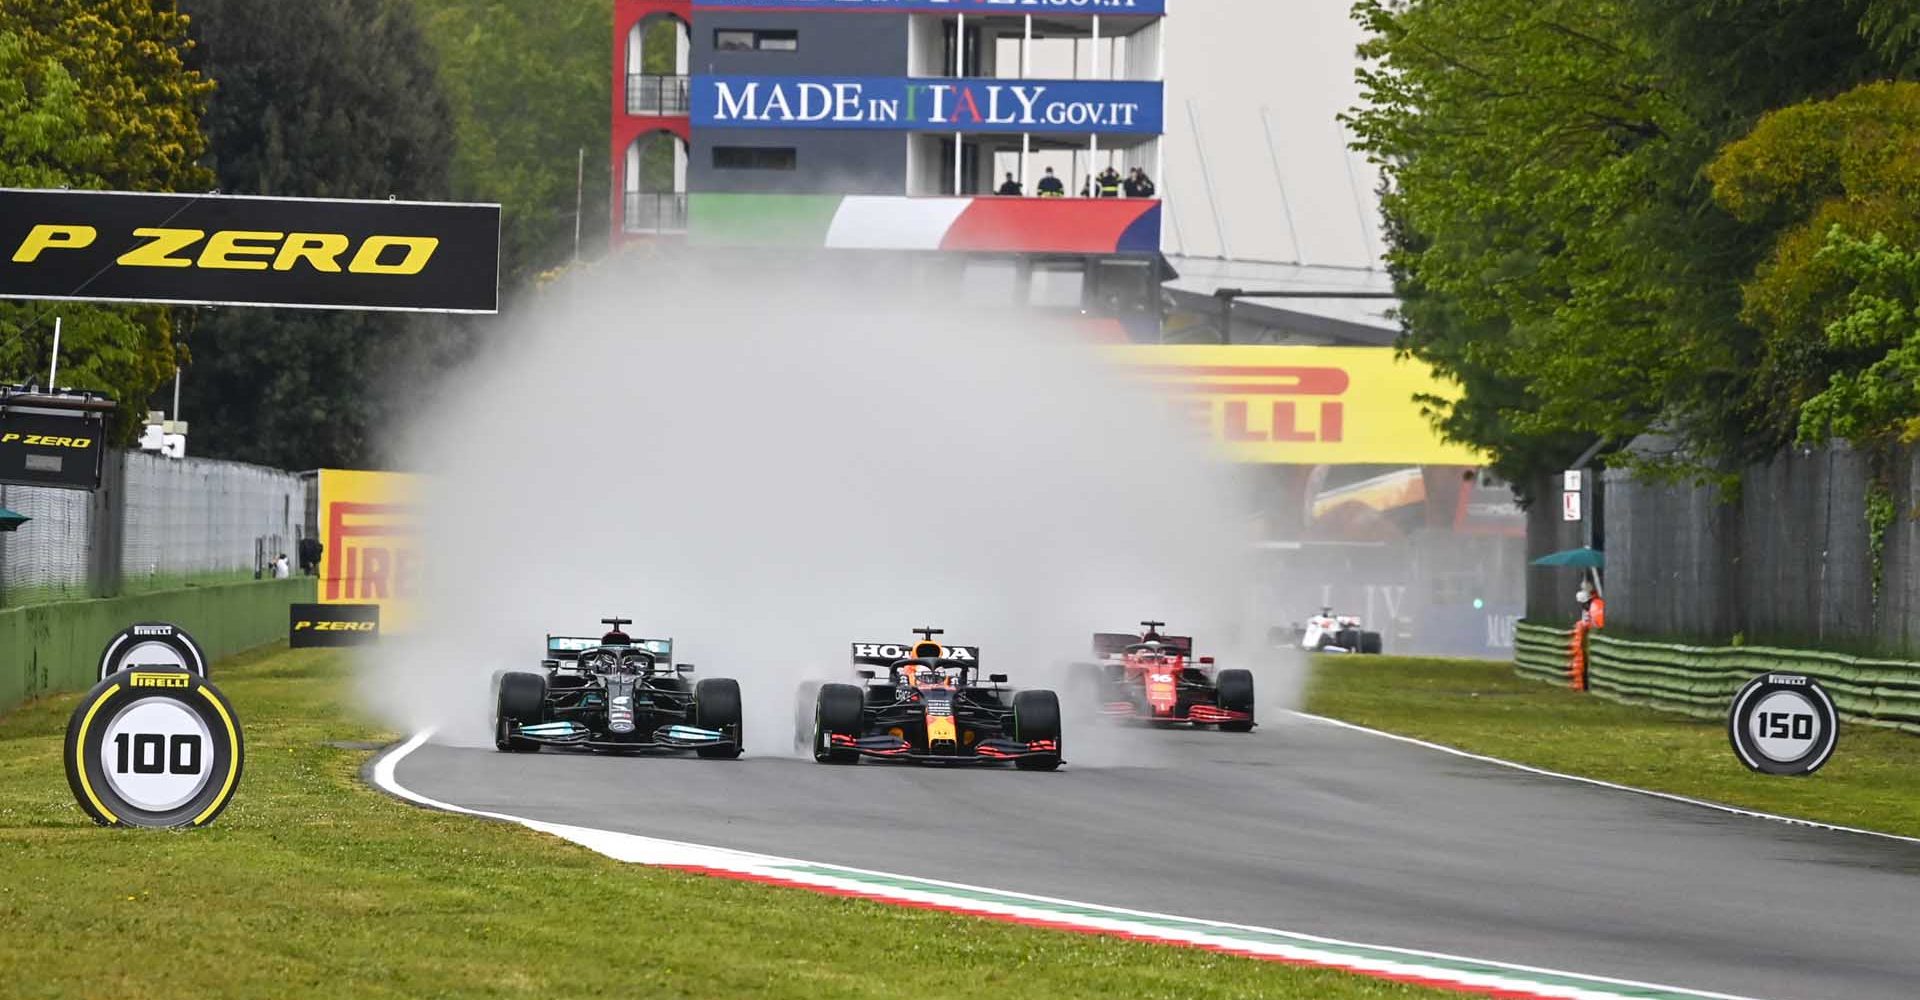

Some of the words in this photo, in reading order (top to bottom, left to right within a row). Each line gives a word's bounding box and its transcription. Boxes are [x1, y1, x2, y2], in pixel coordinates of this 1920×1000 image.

[713, 82, 863, 121] MADE
[867, 99, 899, 121] IN
[12, 224, 97, 263] P
[116, 227, 440, 275] ZERO
[1, 433, 20, 442] P
[22, 434, 92, 448] ZERO
[134, 625, 173, 635] PIRELLI
[294, 621, 311, 631] P
[313, 621, 376, 631] ZERO
[130, 672, 190, 688] PIRELLI
[1151, 673, 1173, 683] 16
[1768, 674, 1807, 685] PIRELLI
[1757, 712, 1813, 740] 150
[114, 733, 202, 775] 100
